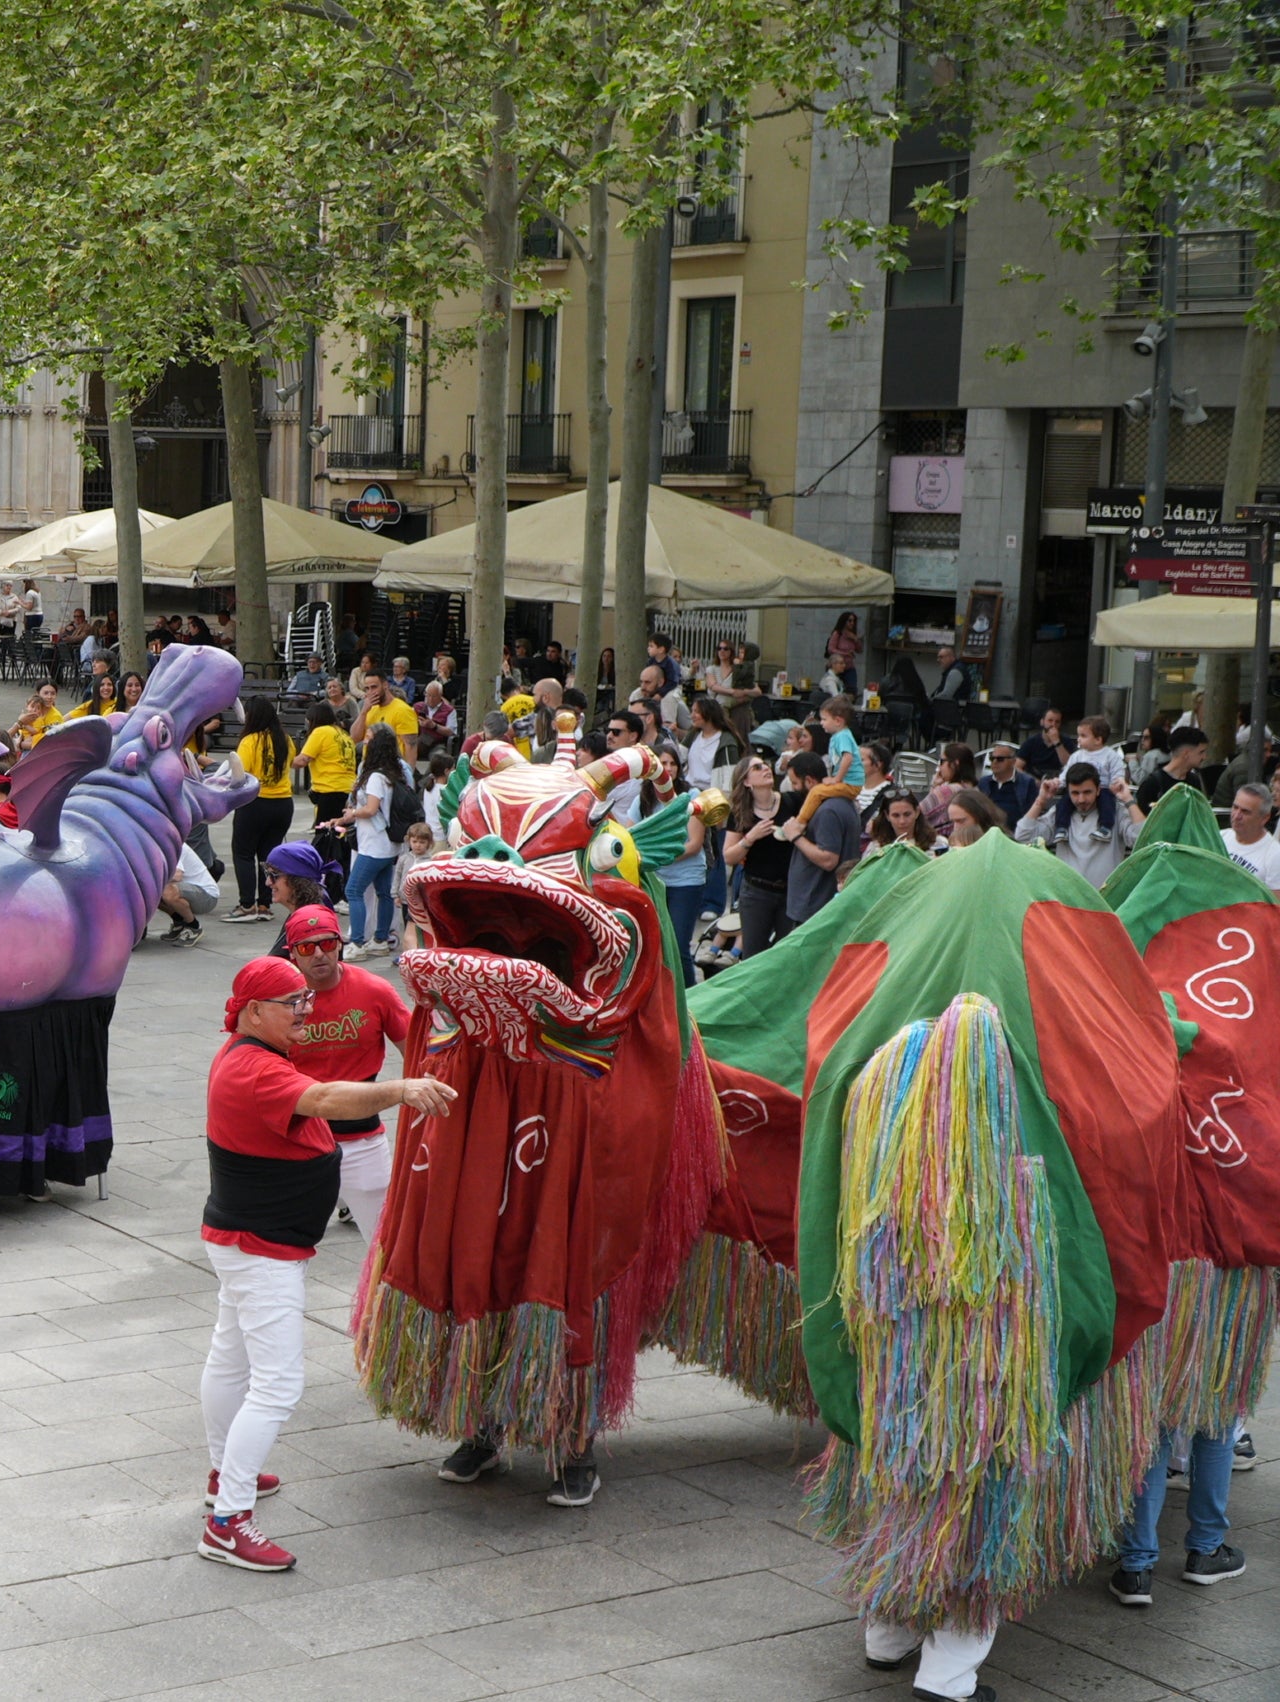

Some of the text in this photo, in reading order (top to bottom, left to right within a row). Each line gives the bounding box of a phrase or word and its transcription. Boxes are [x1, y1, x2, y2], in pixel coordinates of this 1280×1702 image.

[1090, 502, 1219, 524] Marco ldany
[1175, 526, 1247, 537] Plaça del Dr. Robert
[1182, 541, 1206, 550] Alegre
[1207, 541, 1216, 549] de
[1218, 541, 1246, 551] Sagrera
[1213, 549, 1246, 557] Terrassa)
[1203, 564, 1217, 573] Seu
[1199, 570, 1210, 579] de
[1211, 571, 1227, 580] Sant
